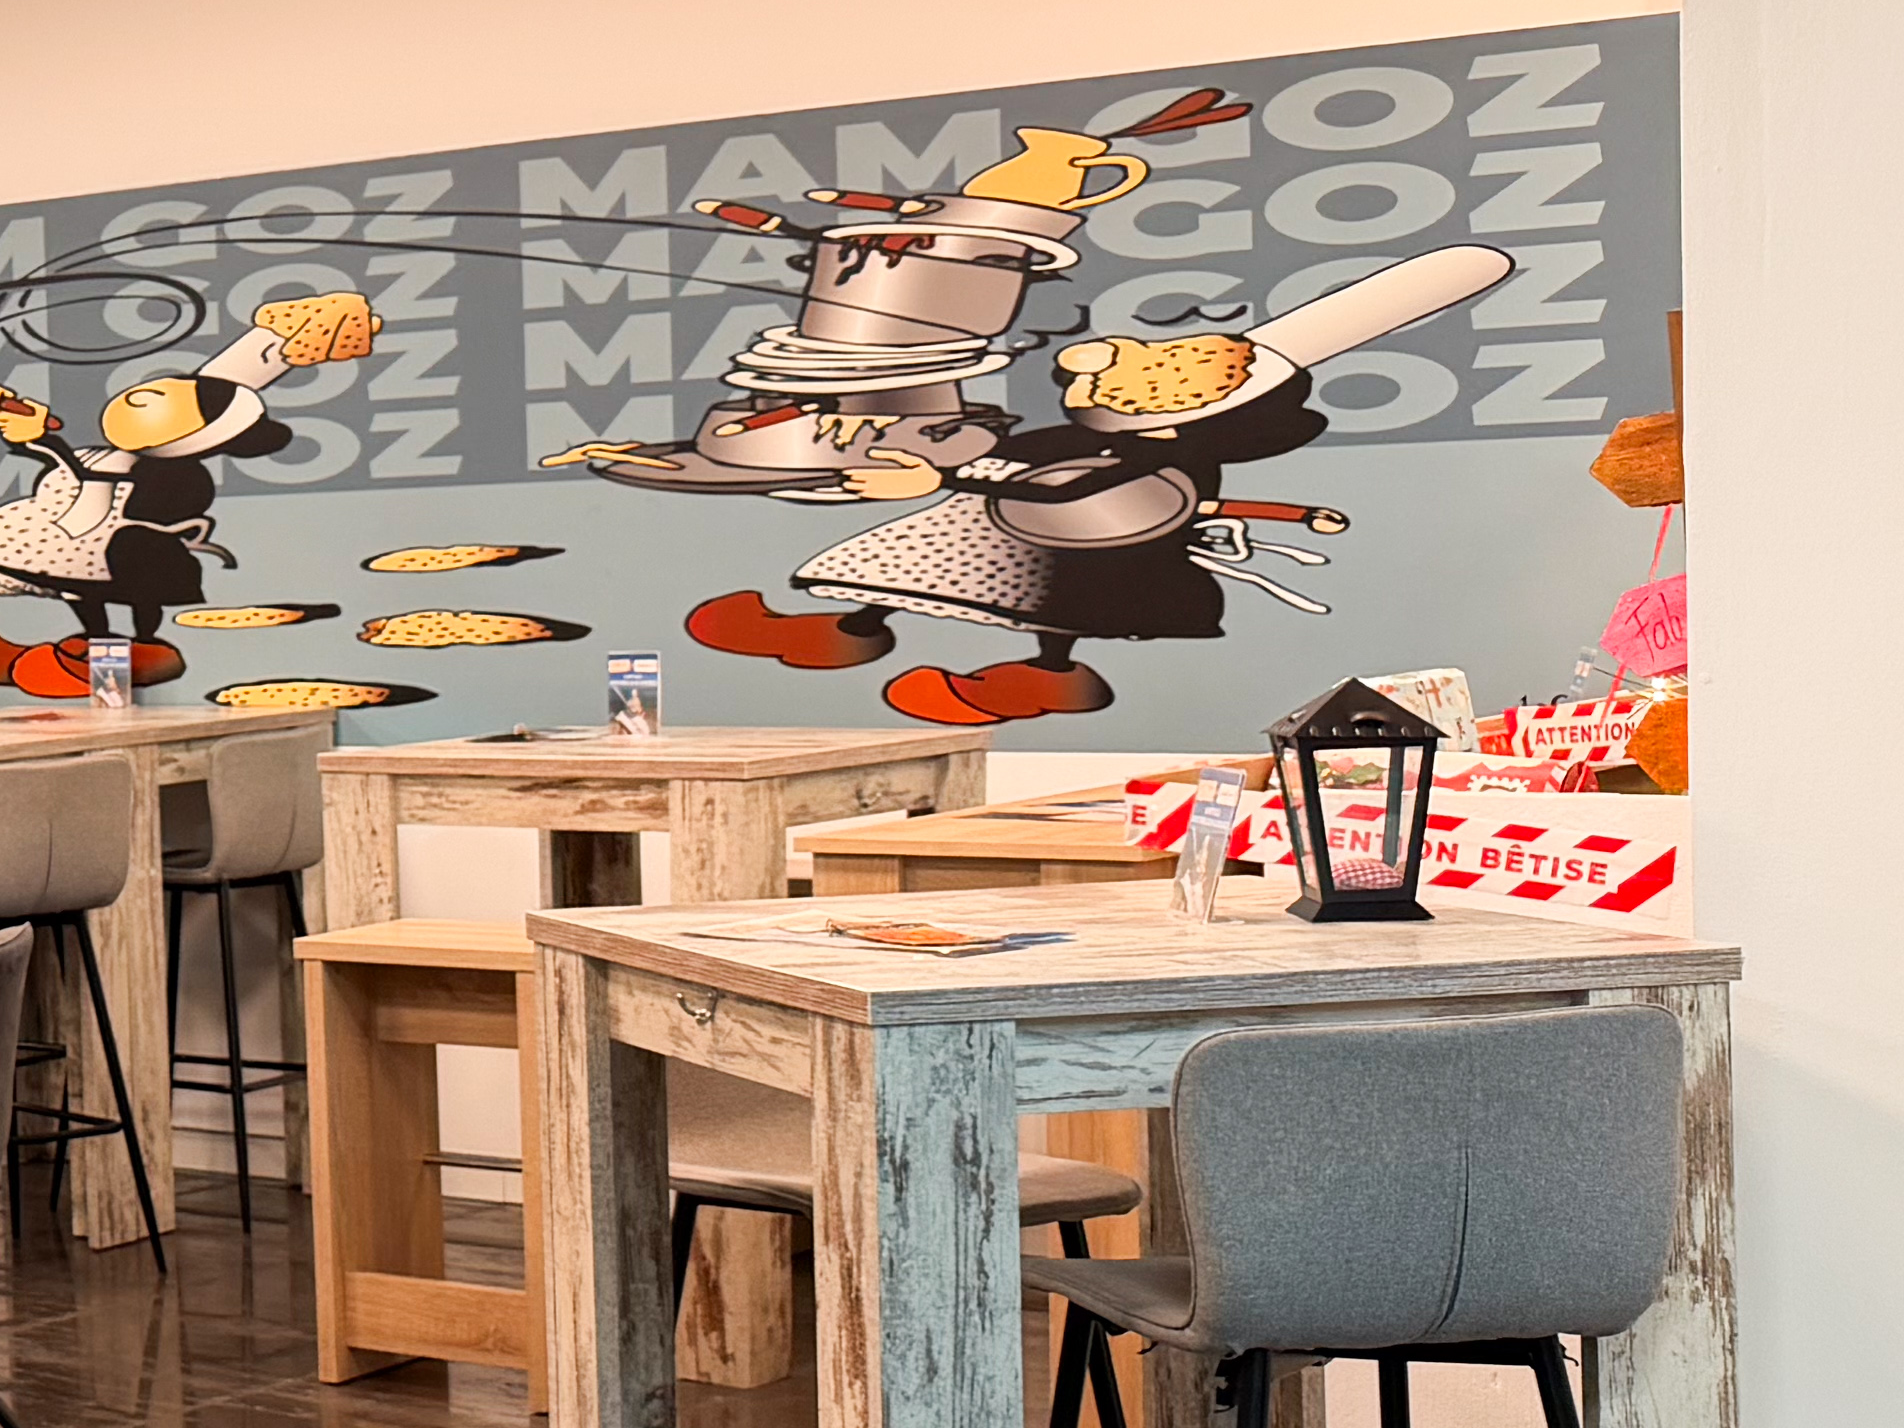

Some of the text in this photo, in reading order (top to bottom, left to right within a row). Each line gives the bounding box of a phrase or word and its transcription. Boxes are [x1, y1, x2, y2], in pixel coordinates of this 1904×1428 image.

[100, 168, 457, 268] GOZ
[518, 108, 1002, 229] MAM
[1084, 42, 1606, 170] GOZ
[1085, 142, 1607, 261] GOZ
[1535, 721, 1635, 746] ATTENTION
[1480, 842, 1609, 885] BÊTISE
